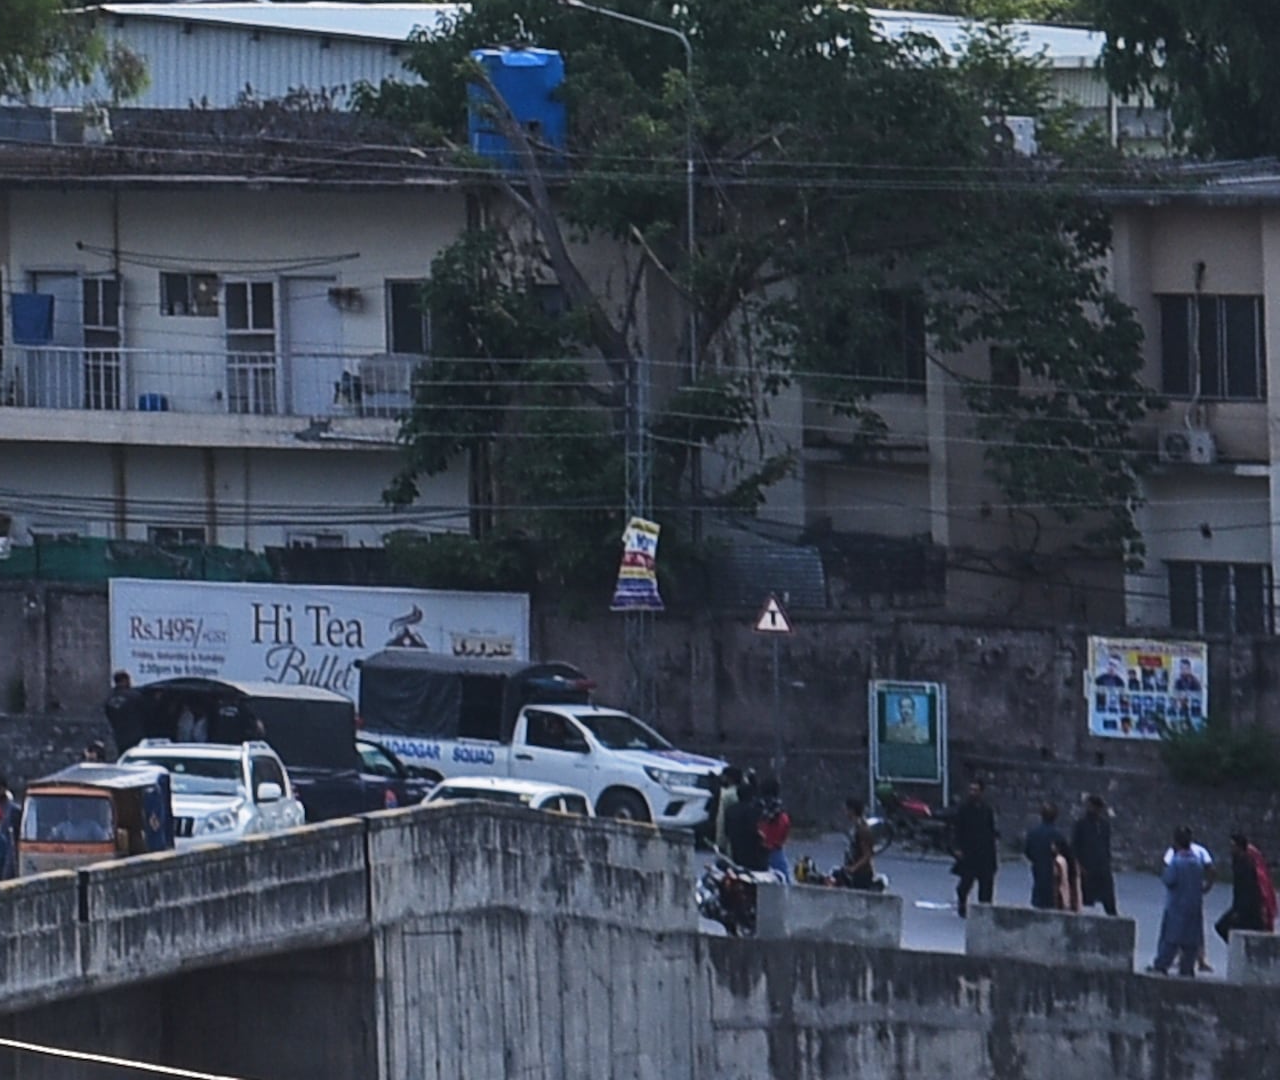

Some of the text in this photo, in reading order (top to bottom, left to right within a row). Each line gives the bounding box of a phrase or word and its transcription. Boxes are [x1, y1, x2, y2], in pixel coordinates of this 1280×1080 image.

[251, 602, 364, 648] Hi Tea
[452, 746, 496, 765] SQUAD
